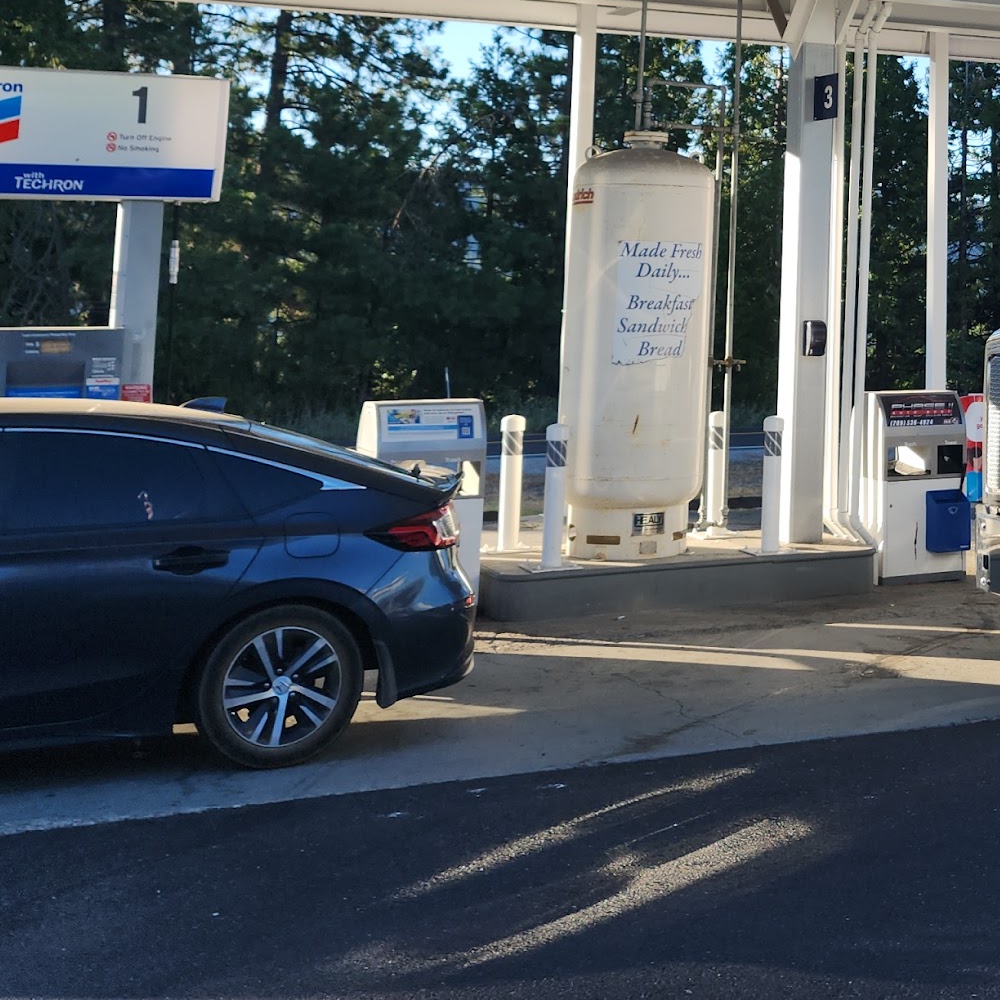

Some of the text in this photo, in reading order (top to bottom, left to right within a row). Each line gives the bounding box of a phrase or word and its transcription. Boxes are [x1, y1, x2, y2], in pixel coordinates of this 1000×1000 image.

[132, 86, 149, 124] 1
[824, 85, 833, 109] 3
[149, 135, 172, 143] Engine
[130, 145, 159, 153] Smoking
[22, 171, 45, 179] with
[14, 176, 84, 192] TECHRON
[619, 242, 702, 260] Made Fresh
[635, 263, 690, 283] Daily...
[626, 295, 695, 315] Breakfast
[637, 340, 683, 357] Bread
